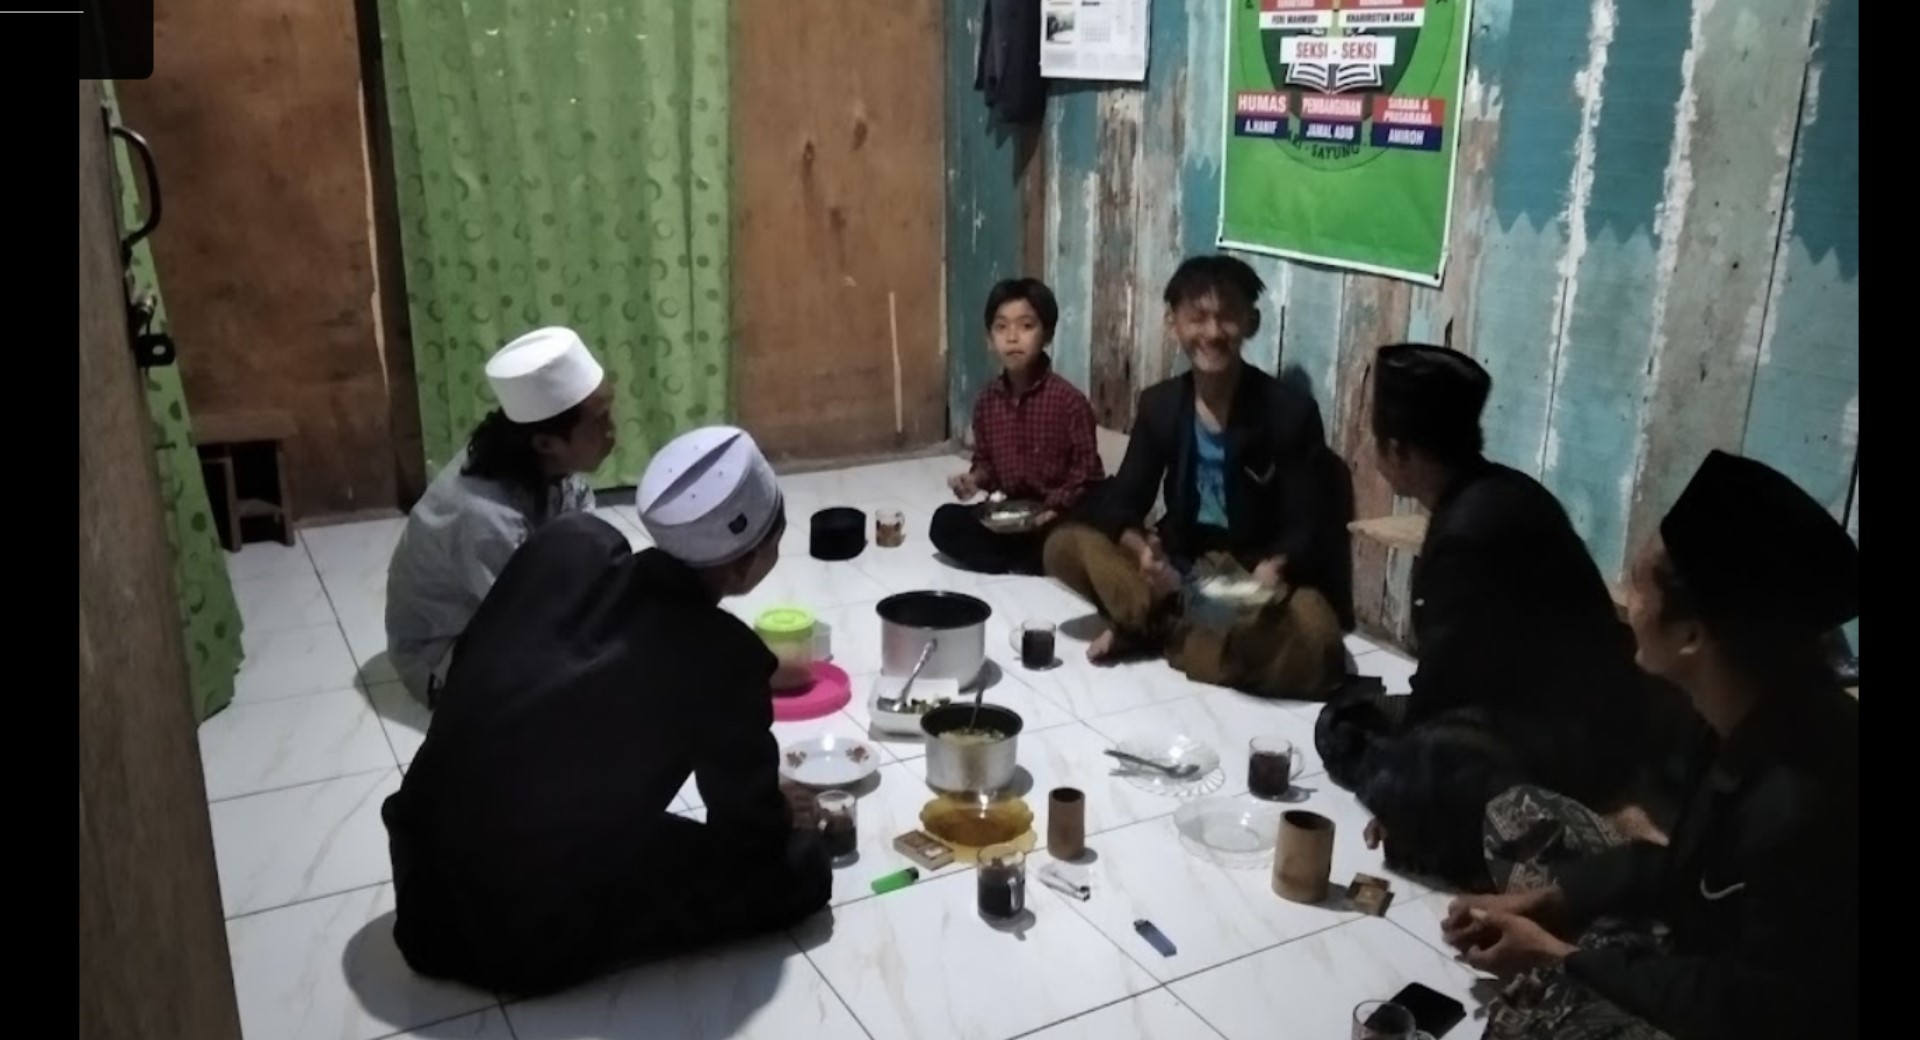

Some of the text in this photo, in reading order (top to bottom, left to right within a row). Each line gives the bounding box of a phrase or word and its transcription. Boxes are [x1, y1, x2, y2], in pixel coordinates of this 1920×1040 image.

[1296, 42, 1328, 58] SEKSI
[1341, 42, 1377, 58] SEKSI
[1237, 94, 1287, 113] HUMAS
[1302, 97, 1362, 117] PEMBANGUNAN
[1388, 97, 1420, 110] SARANA
[1306, 123, 1354, 140] JAMAL ADIB
[1388, 129, 1425, 145] AMIROH
